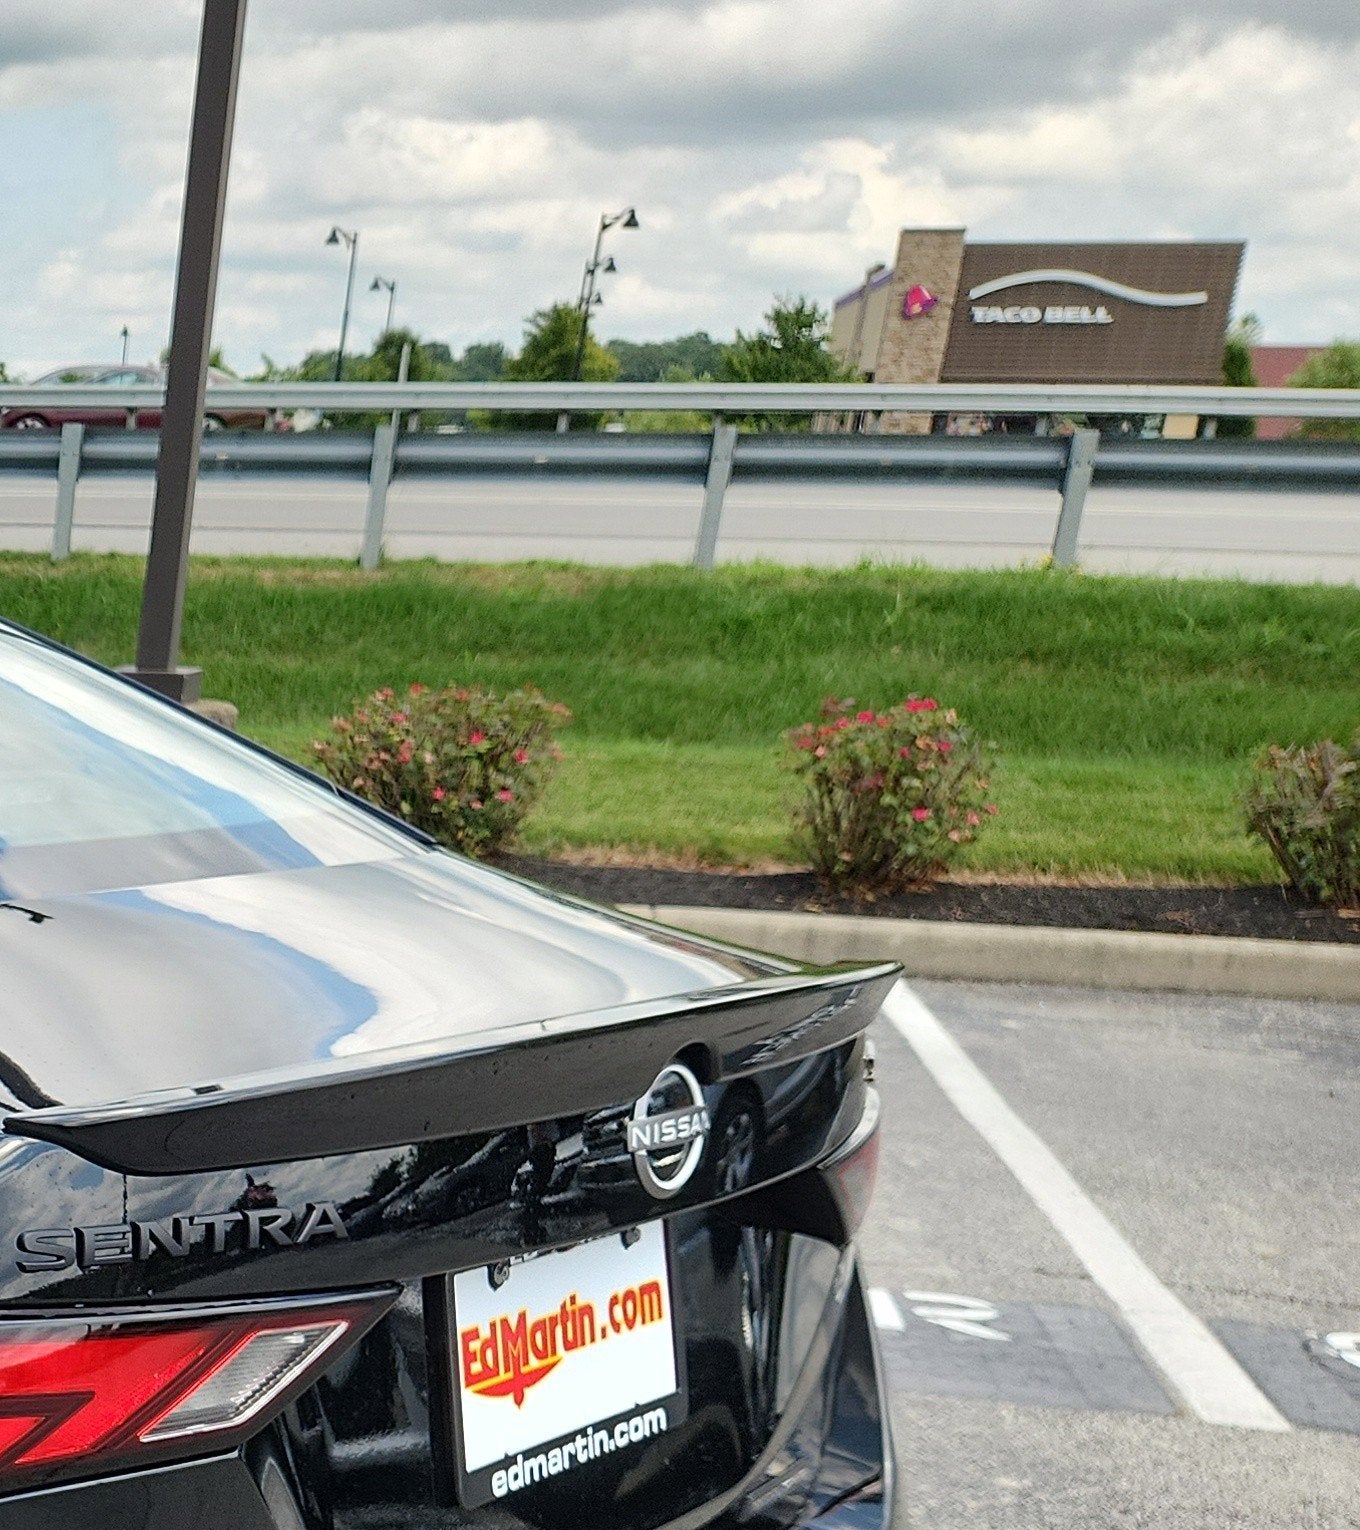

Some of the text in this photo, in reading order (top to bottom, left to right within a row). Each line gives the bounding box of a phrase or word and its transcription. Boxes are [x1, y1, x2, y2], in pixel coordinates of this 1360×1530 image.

[971, 306, 1114, 323] TACO BELL
[14, 1199, 351, 1275] SENTRA
[490, 1404, 669, 1500] edmartin.com
